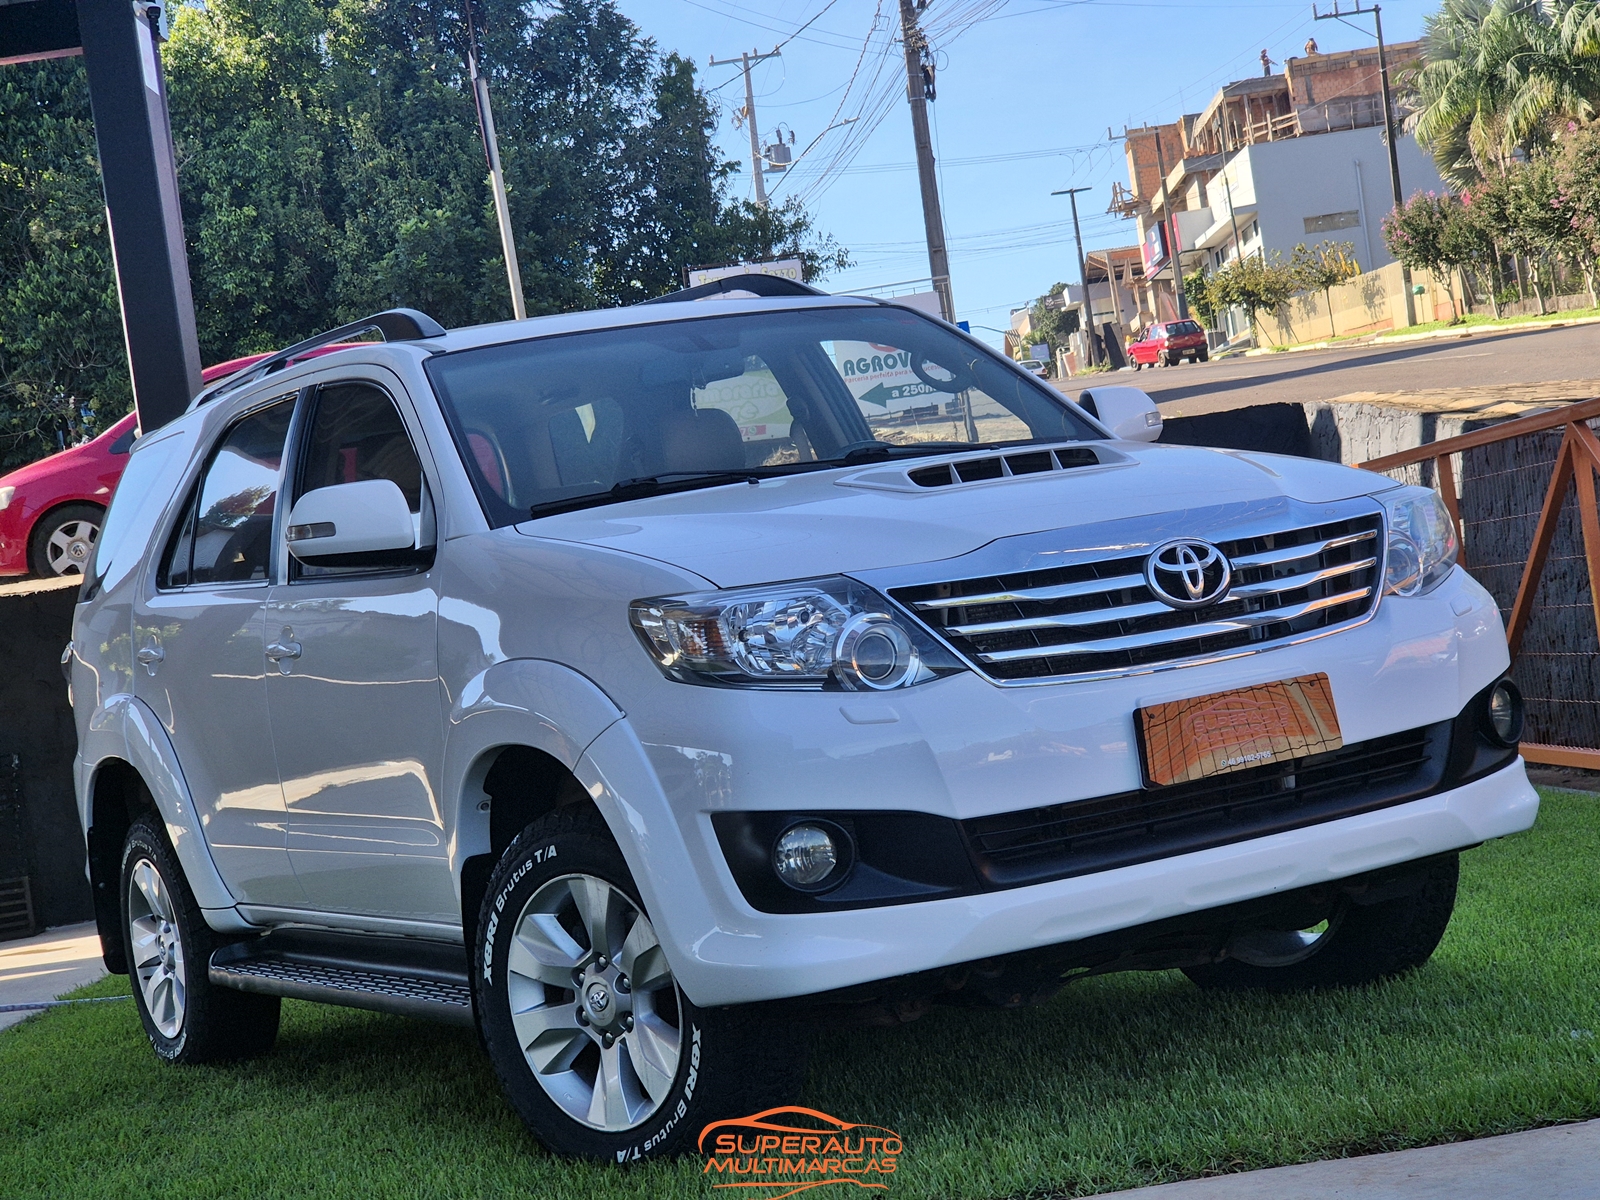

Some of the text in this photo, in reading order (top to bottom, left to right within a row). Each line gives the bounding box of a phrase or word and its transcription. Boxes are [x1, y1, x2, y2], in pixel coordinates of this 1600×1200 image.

[843, 352, 910, 376] AGROV
[892, 389, 900, 398] a
[1194, 705, 1289, 733] SUPERAUTO
[483, 844, 557, 986] XBRI Brutus T/A
[644, 1099, 688, 1151] Brutus
[616, 1147, 642, 1164] T/A
